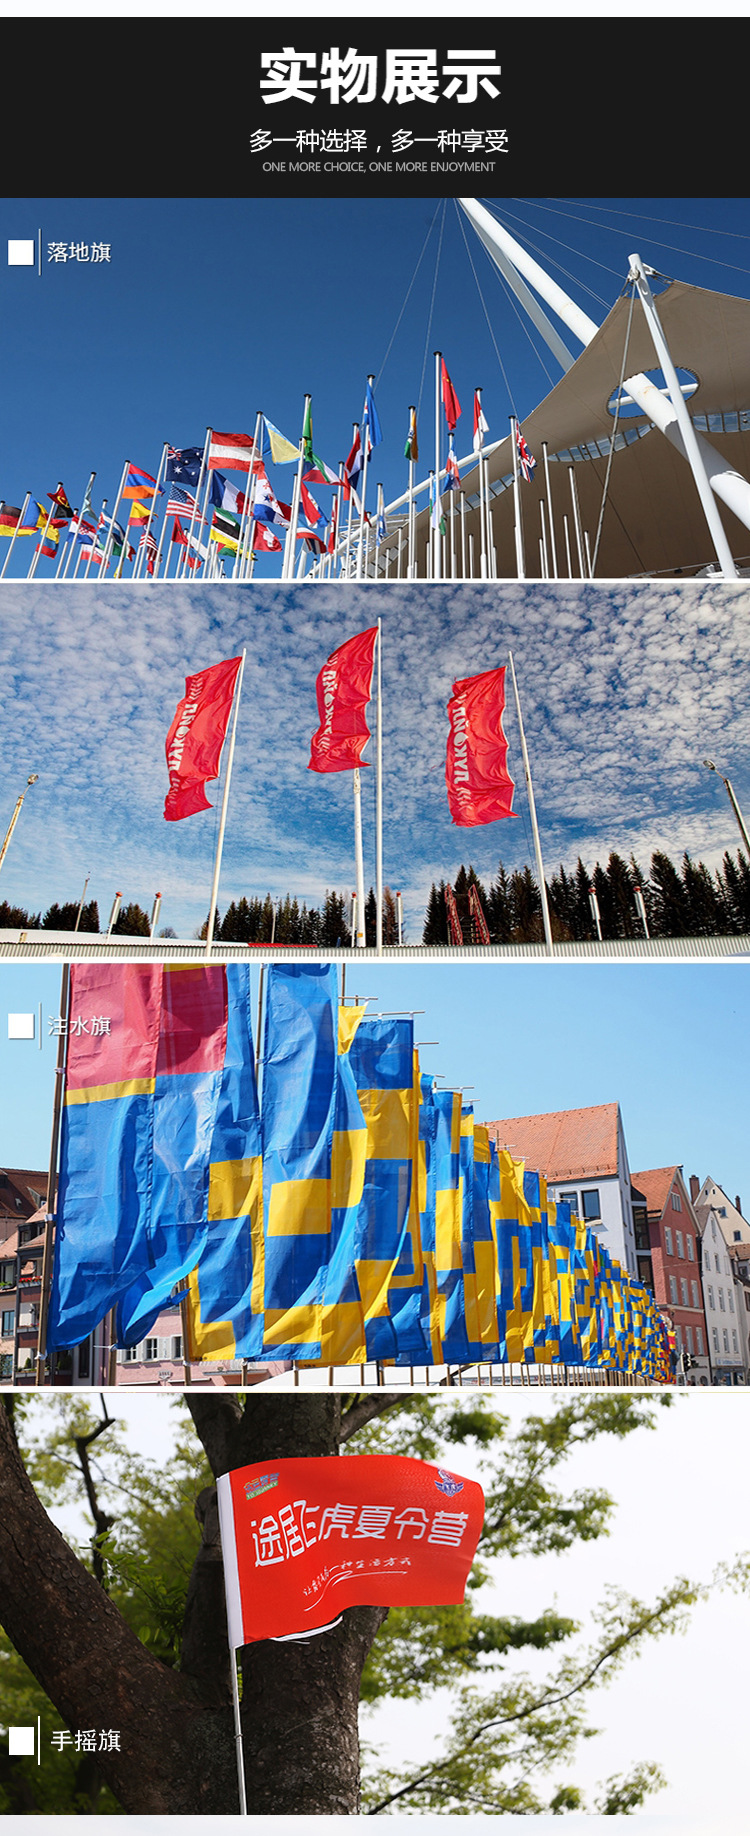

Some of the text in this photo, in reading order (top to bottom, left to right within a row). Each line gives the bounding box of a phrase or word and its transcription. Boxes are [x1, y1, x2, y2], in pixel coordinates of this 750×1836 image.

[251, 1500, 469, 1567] 途居飞虎夏令营
